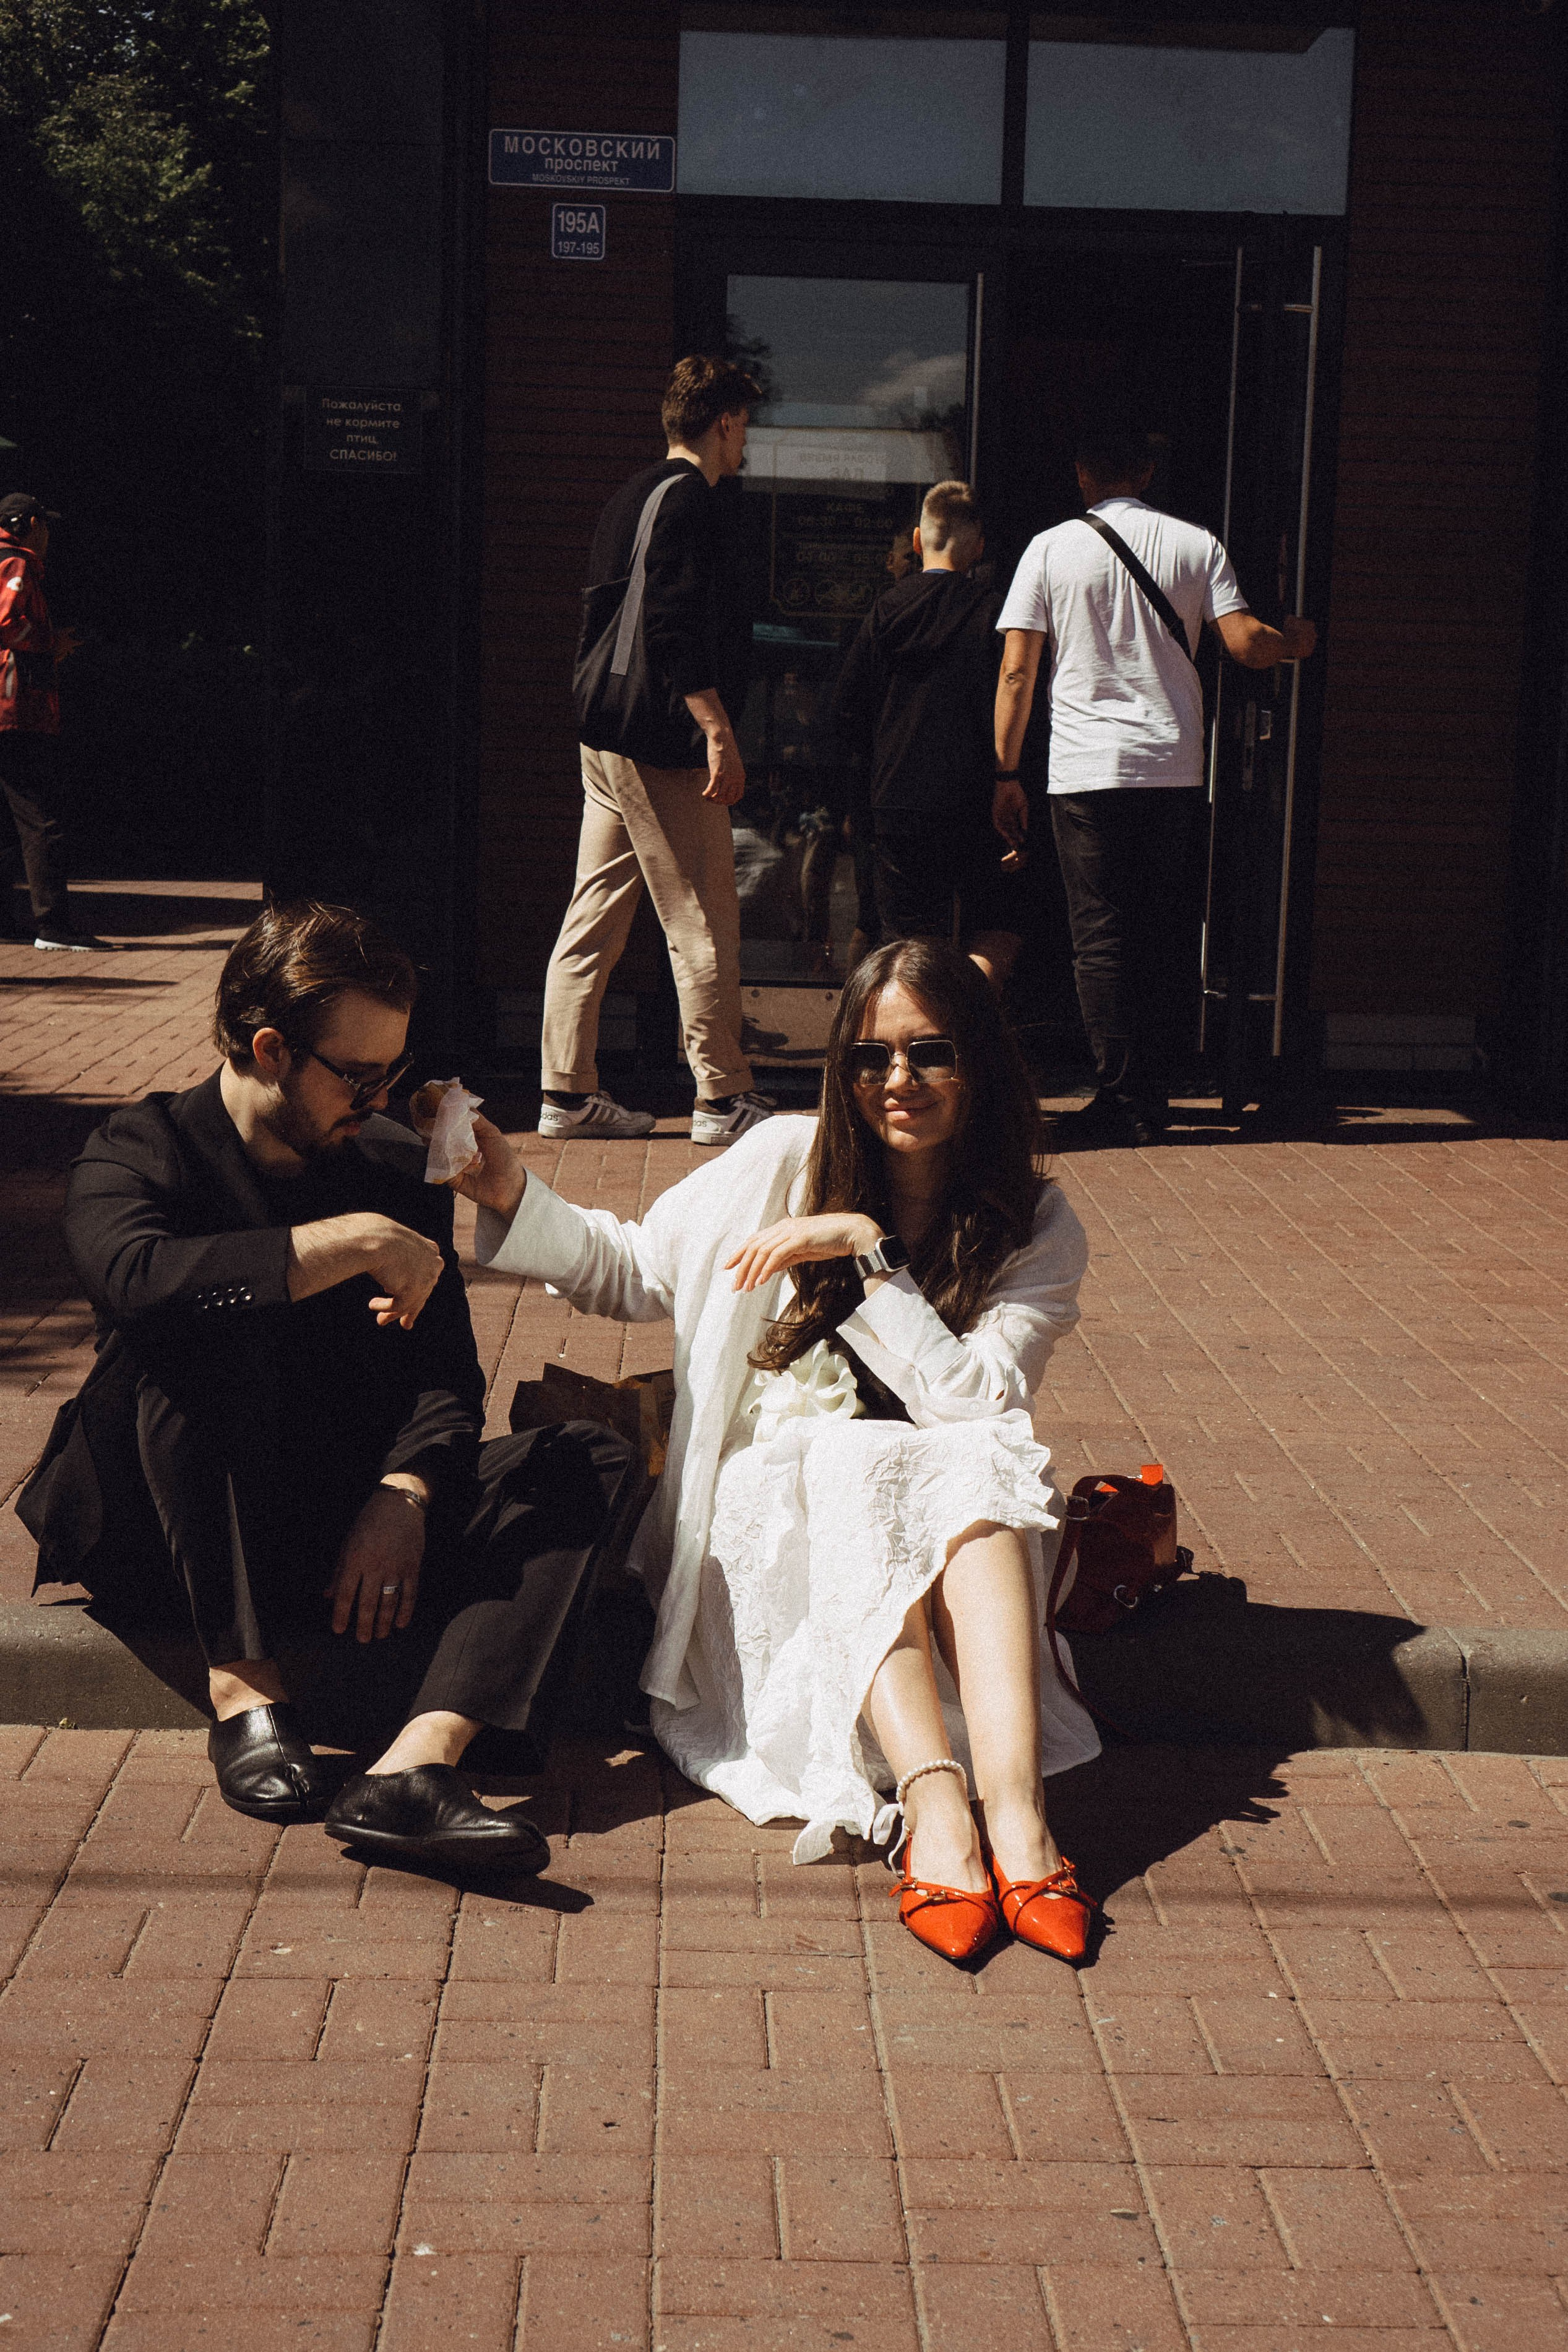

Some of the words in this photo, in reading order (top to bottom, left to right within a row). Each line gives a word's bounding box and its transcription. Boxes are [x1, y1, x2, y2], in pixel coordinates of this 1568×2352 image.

[504, 136, 660, 159] МОСКОВСКИЙ
[545, 157, 619, 173] проспект
[532, 173, 585, 184] MOSKOVSKIY
[587, 176, 631, 186] PROSPEKT
[558, 241, 600, 254] 197-195
[326, 418, 342, 426] не
[345, 418, 401, 429] кормите
[329, 449, 397, 462] СПАСИБО!
